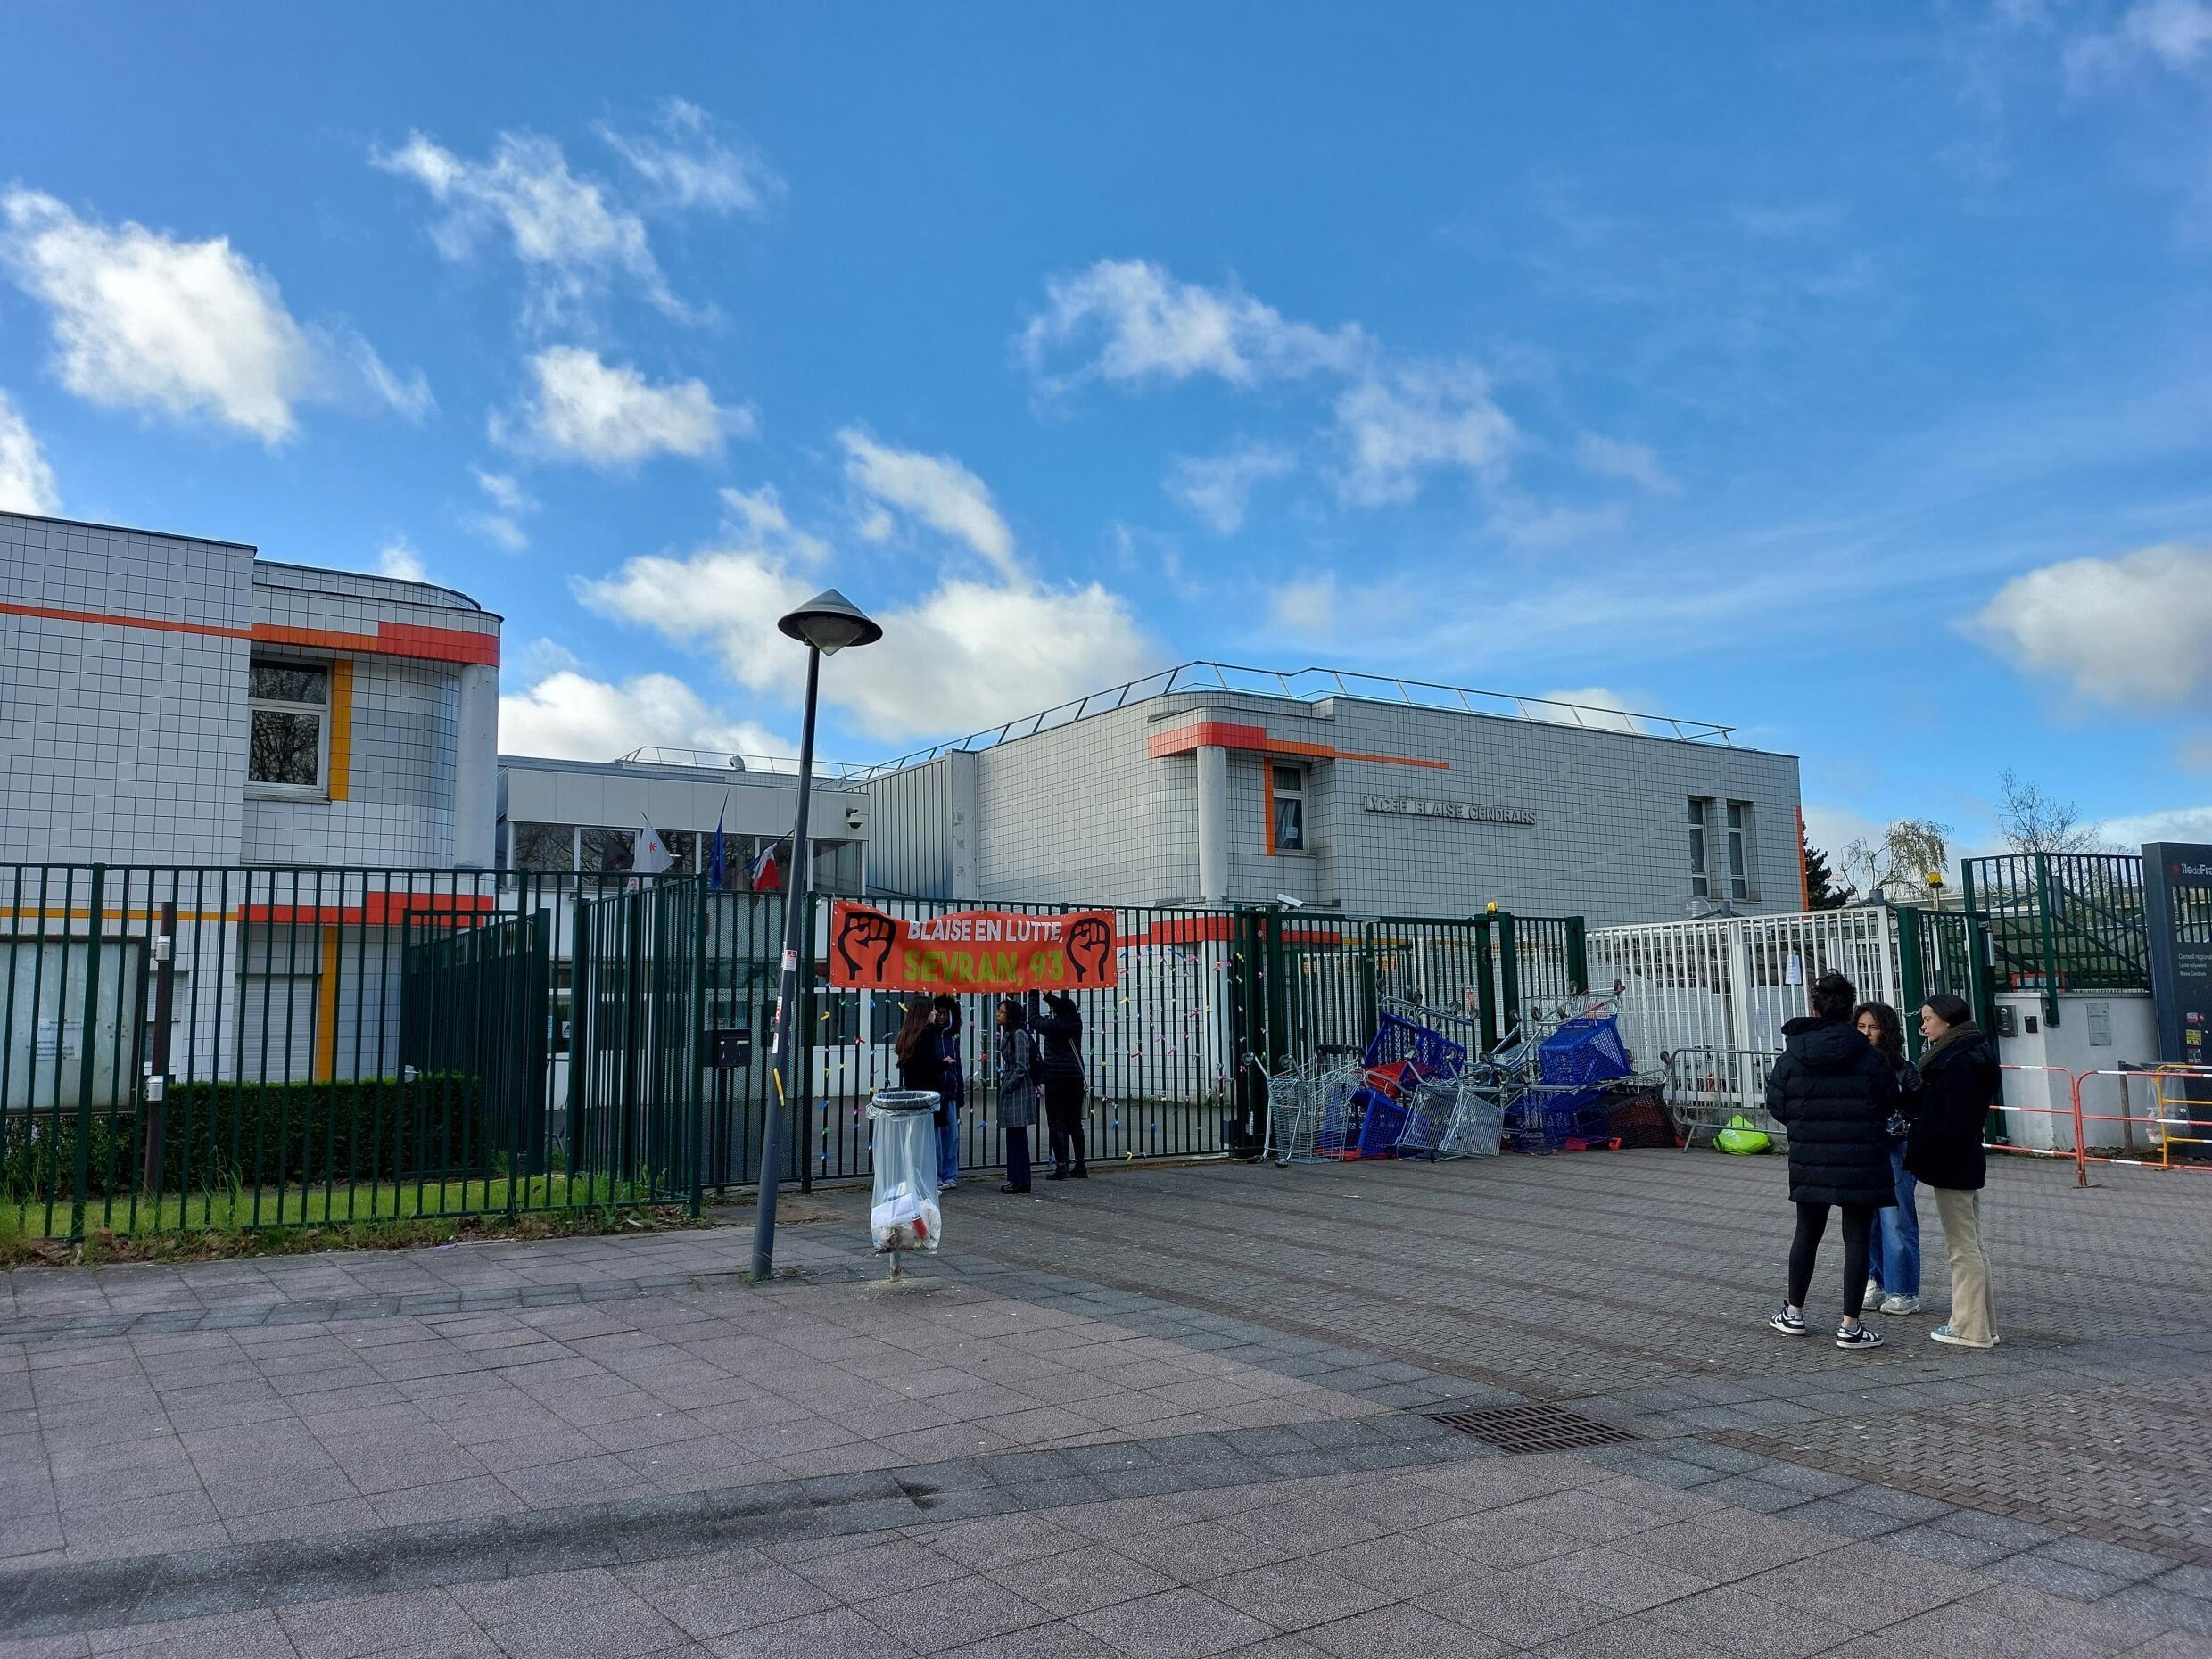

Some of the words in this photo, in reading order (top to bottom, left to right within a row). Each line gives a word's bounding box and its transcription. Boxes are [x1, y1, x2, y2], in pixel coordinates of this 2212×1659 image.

[1416, 801, 1464, 819] BLAISE
[1469, 805, 1536, 824] CENDRARS
[907, 919, 971, 941] BLAISE
[975, 920, 1002, 942] EN
[1005, 920, 1064, 944] LUTTE,
[903, 948, 1024, 986] SEVRAN,
[1030, 949, 1065, 982] 93
